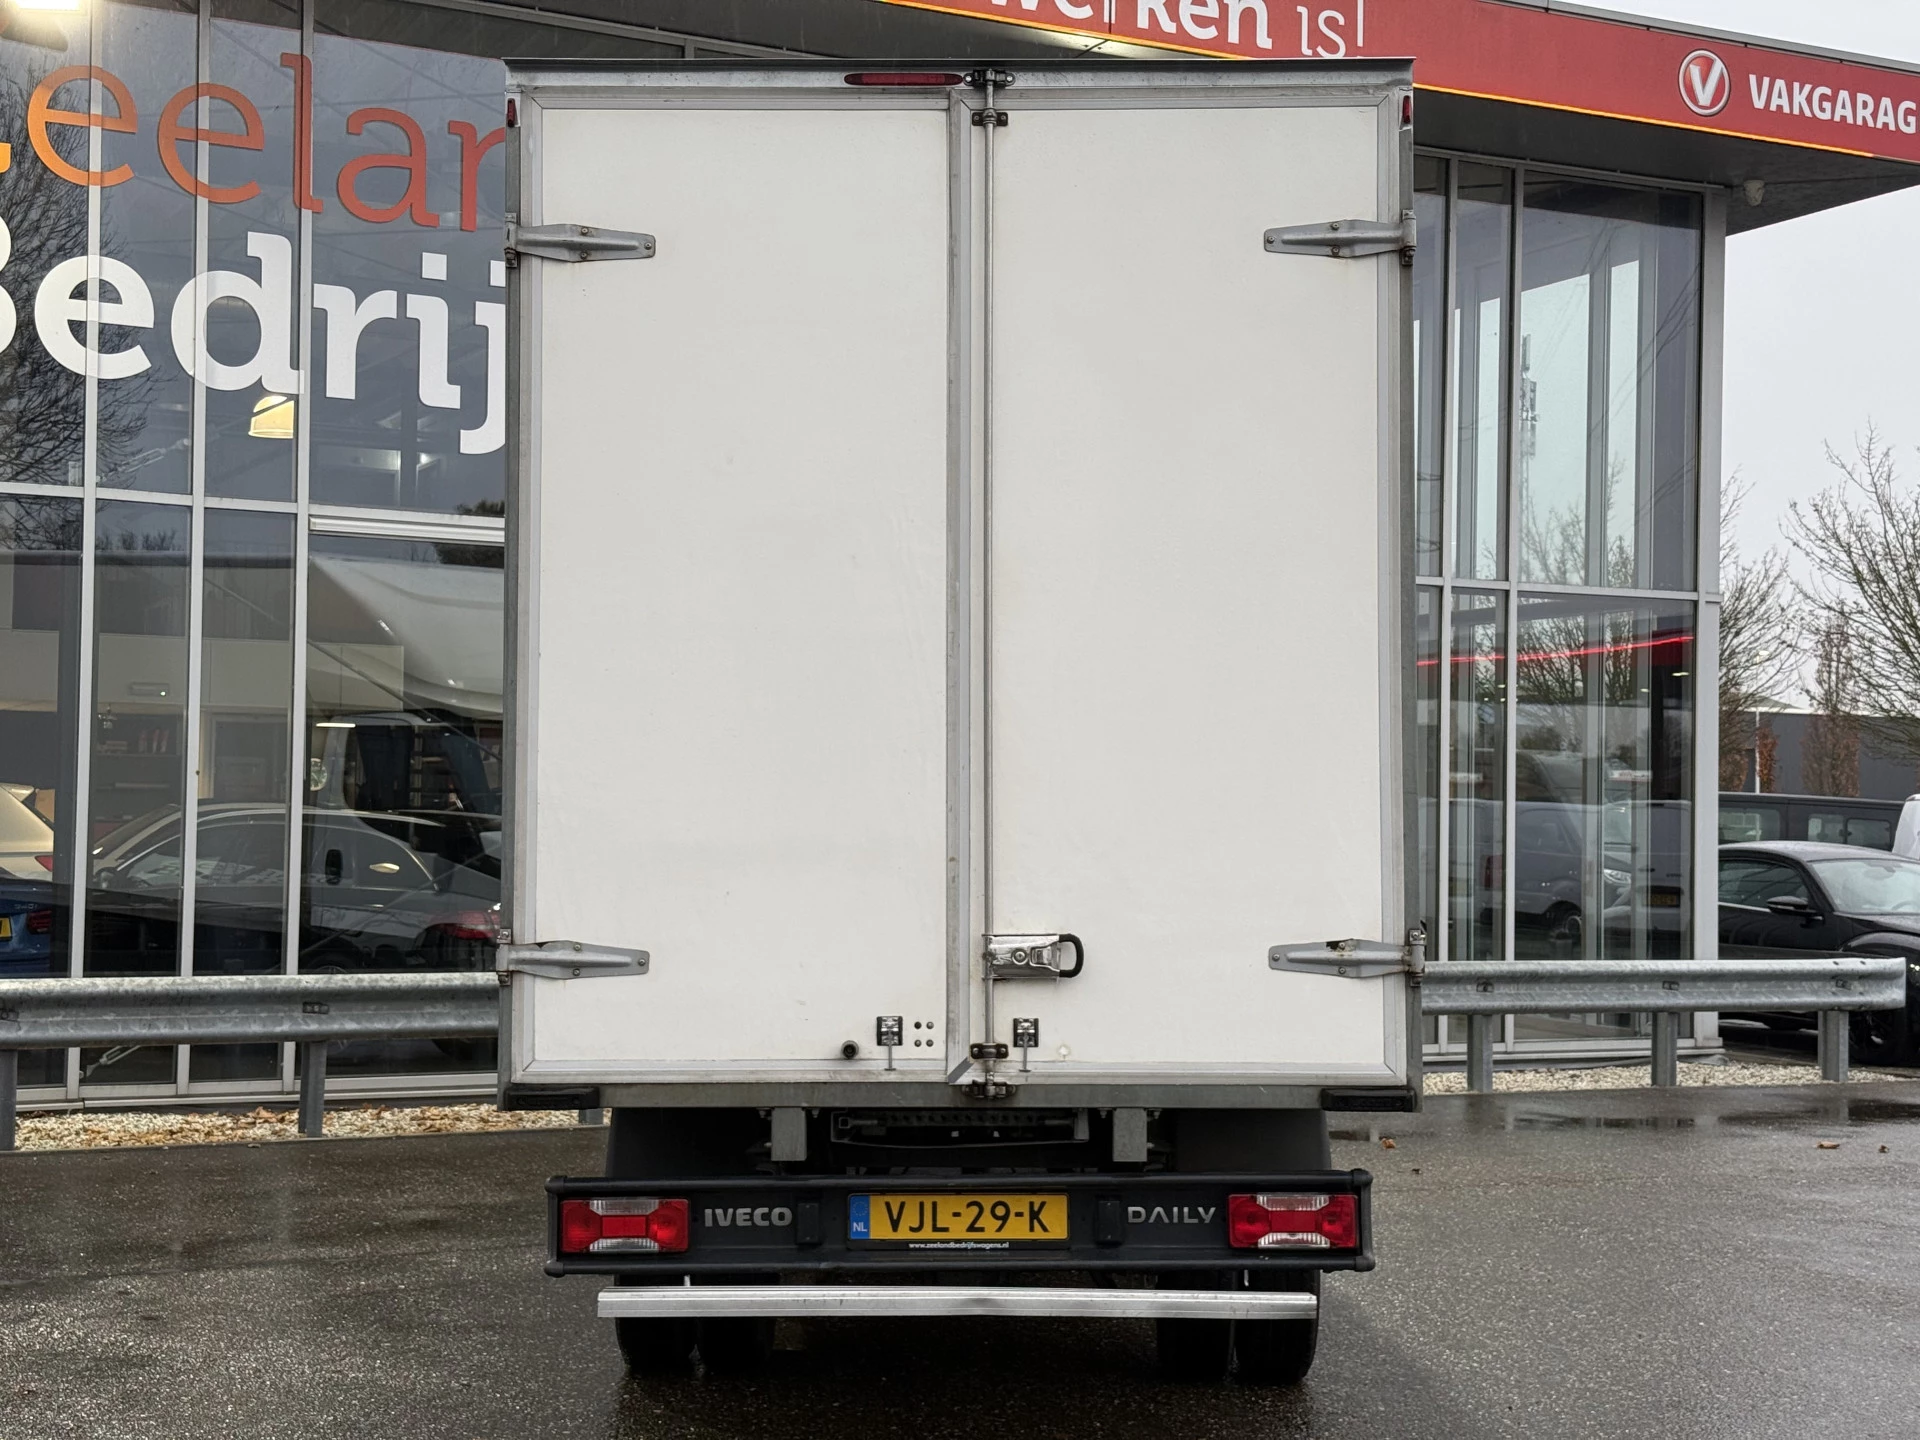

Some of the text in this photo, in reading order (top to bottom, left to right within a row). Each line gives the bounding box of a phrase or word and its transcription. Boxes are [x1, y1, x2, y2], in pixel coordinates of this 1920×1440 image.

[1749, 73, 1917, 134] VAKGARAG
[0, 52, 506, 232] eela
[704, 1207, 793, 1227] IVECO
[853, 1200, 1050, 1233] NL VJL-29-K
[1127, 1206, 1217, 1224] DAILY
